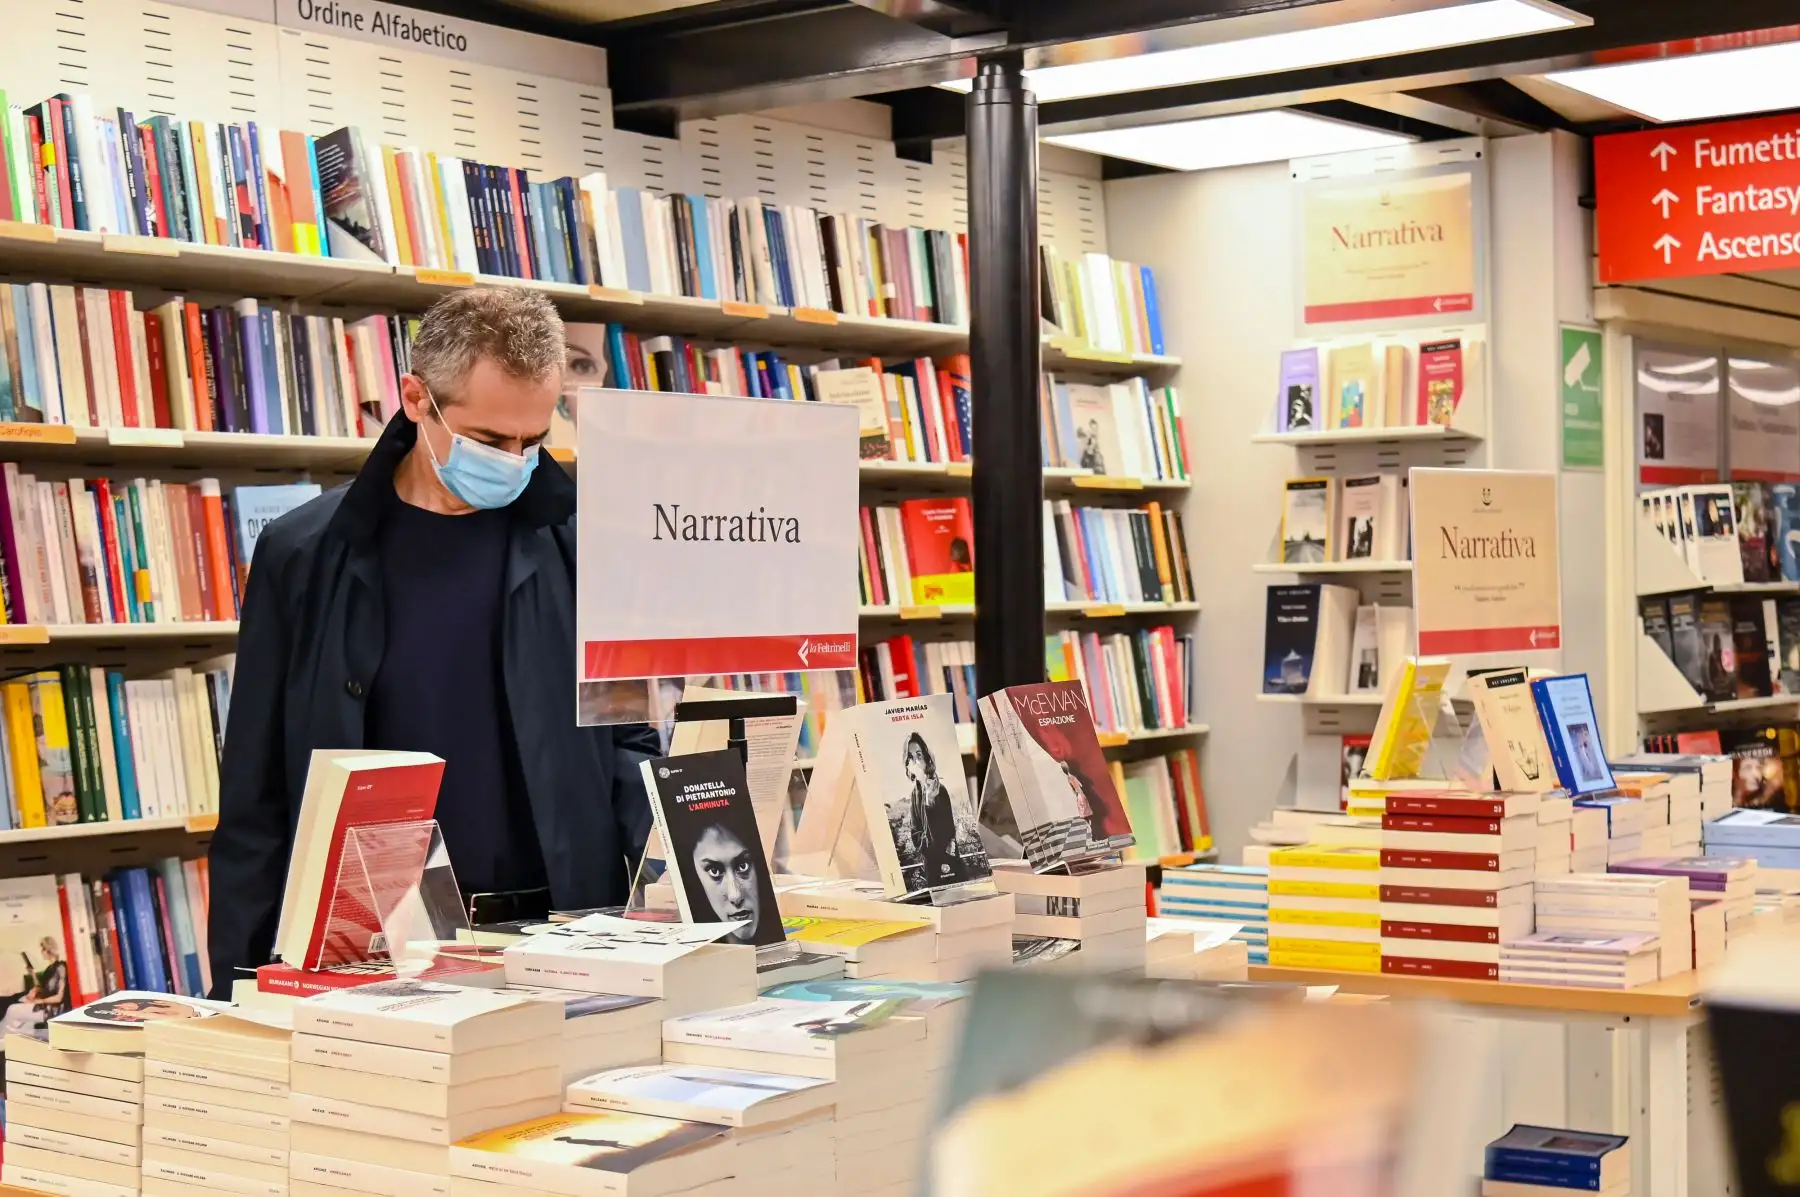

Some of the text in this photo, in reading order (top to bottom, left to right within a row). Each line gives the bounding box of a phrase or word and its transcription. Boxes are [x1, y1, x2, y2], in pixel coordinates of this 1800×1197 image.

[297, 0, 467, 51] Ordine Alfabetico
[1695, 128, 1800, 168] Fumetti
[1696, 184, 1800, 216] Fantasy
[1332, 220, 1444, 251] Narrativa
[652, 503, 801, 543] Narrativa
[1440, 526, 1536, 560] Narrativa
[818, 641, 851, 653] Feltrinelli
[885, 704, 928, 715] JAVIER MARÍAS
[1038, 715, 1076, 727] ESPIAZIONE
[683, 780, 726, 793] DONATELLA
[675, 788, 736, 803] DI PIETRANTONIO
[688, 799, 730, 812] L'ARMINUTA
[268, 978, 294, 987] MURAKAMI
[302, 982, 331, 991] NORWEGIAN
